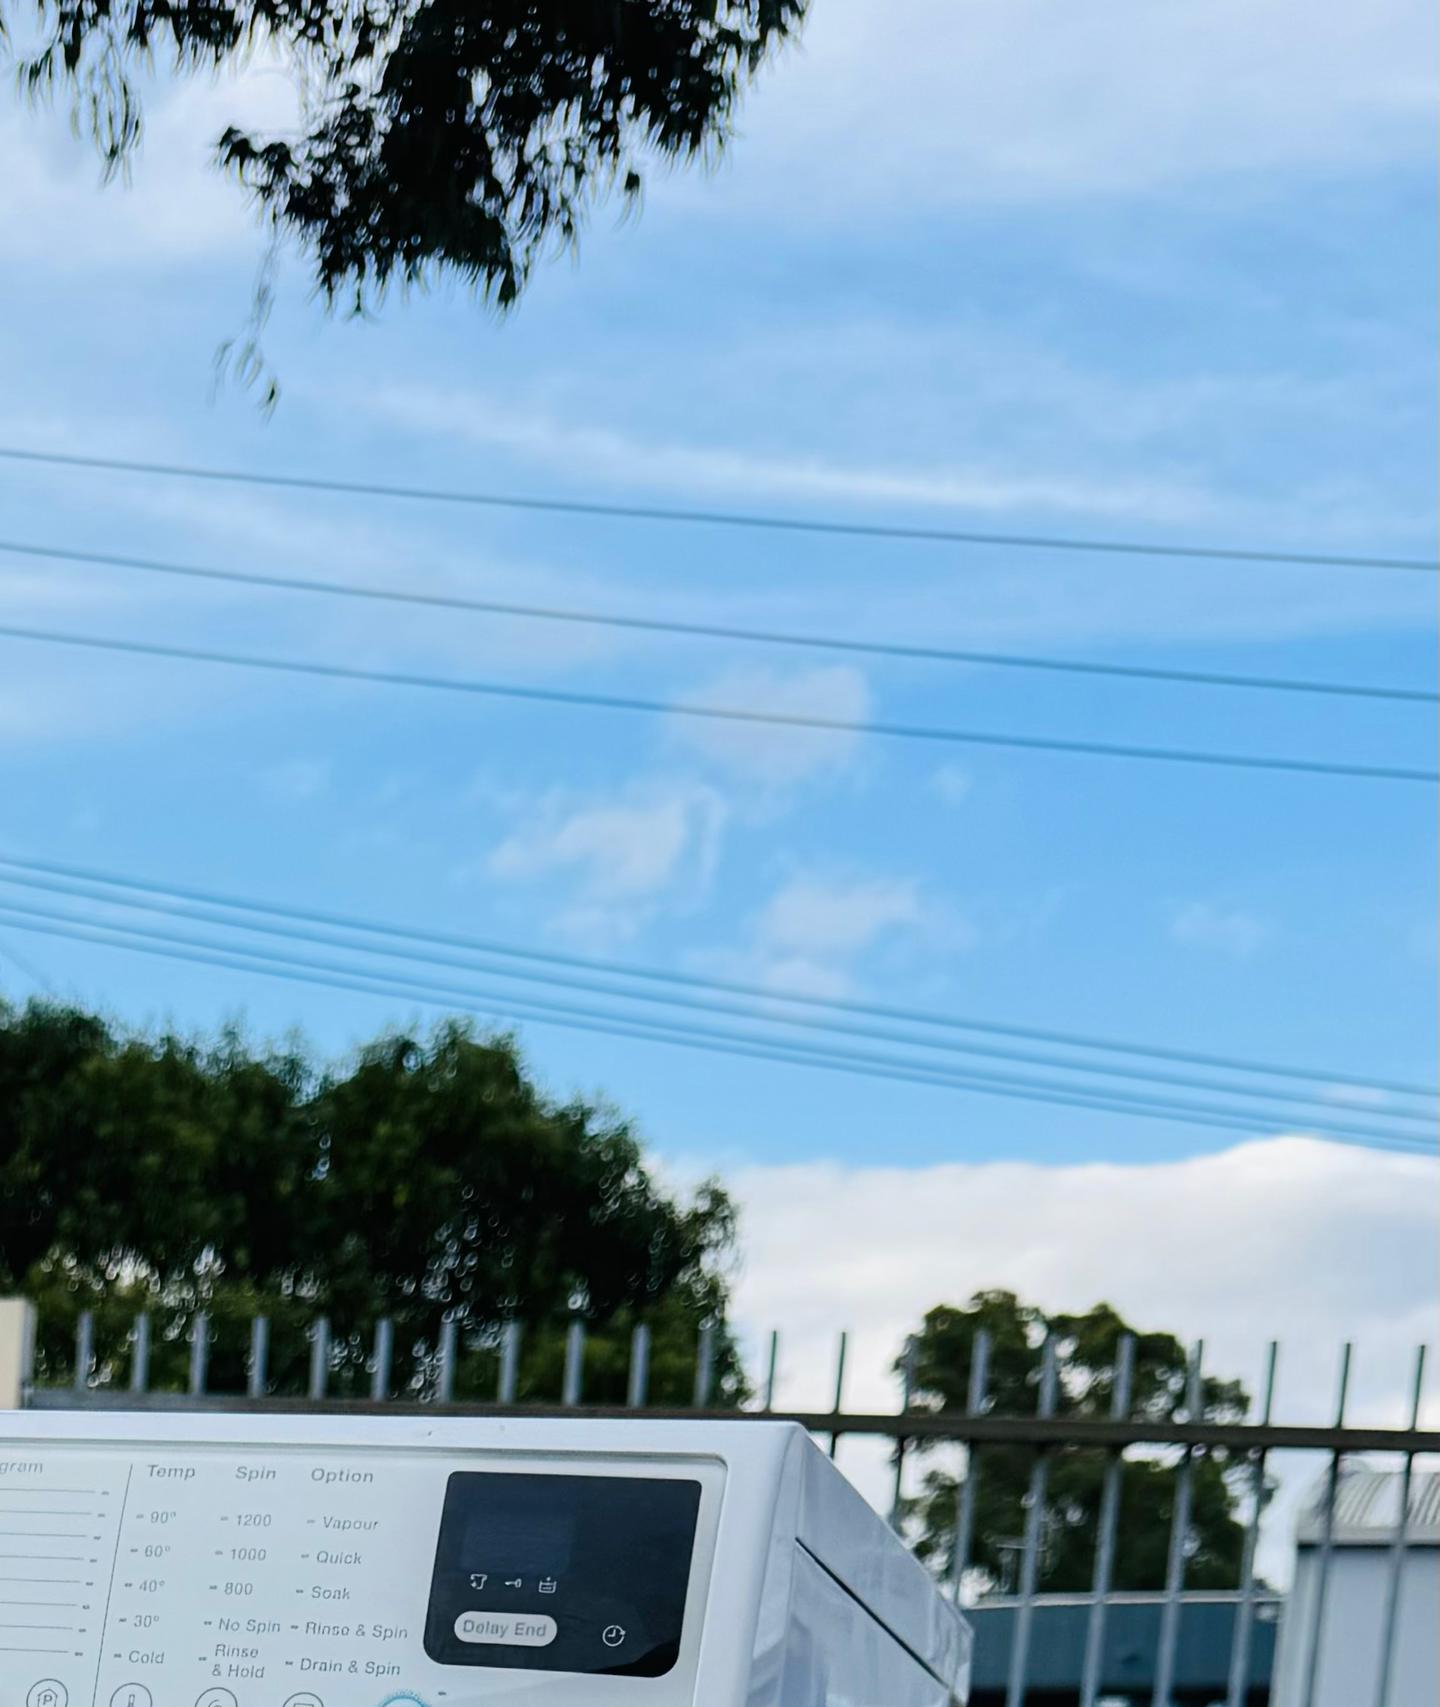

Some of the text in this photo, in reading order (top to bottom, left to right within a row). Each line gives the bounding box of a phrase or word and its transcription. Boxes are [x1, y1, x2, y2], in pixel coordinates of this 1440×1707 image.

[147, 1464, 196, 1481] Temp
[235, 1465, 277, 1482] Spin
[310, 1467, 374, 1484] Option
[236, 1513, 272, 1527] 1200
[322, 1515, 379, 1531] Vapour
[230, 1548, 267, 1562] 1000
[316, 1550, 362, 1565] Quick
[223, 1582, 254, 1595] 800
[311, 1585, 351, 1600] Soak
[218, 1617, 281, 1634] No Spin
[305, 1620, 409, 1641] Rinse & Spin
[463, 1619, 548, 1638] Delay End
[128, 1650, 165, 1665] Cold
[214, 1643, 259, 1658] Rinse
[211, 1663, 265, 1679] & Hold
[300, 1657, 401, 1677] Drain & Spin
